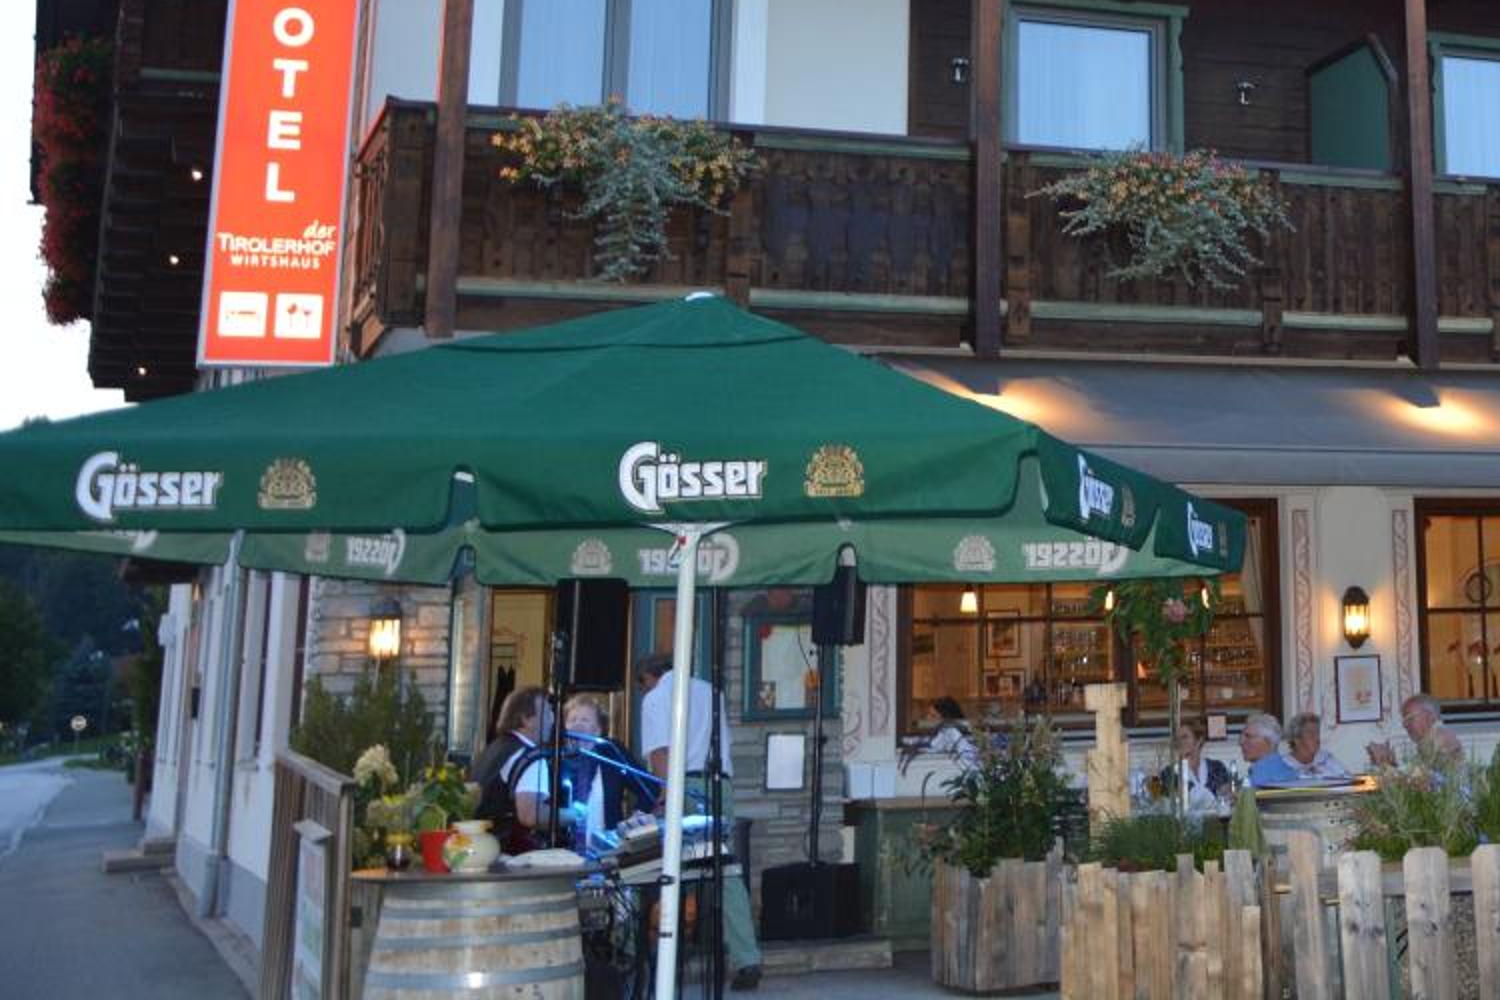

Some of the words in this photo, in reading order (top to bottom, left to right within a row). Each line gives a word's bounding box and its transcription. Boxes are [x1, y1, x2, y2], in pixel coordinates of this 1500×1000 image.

[303, 219, 337, 239] der
[231, 254, 320, 270] WIRTSHAUS
[76, 451, 224, 521] Gösser
[619, 441, 767, 515] Gösser
